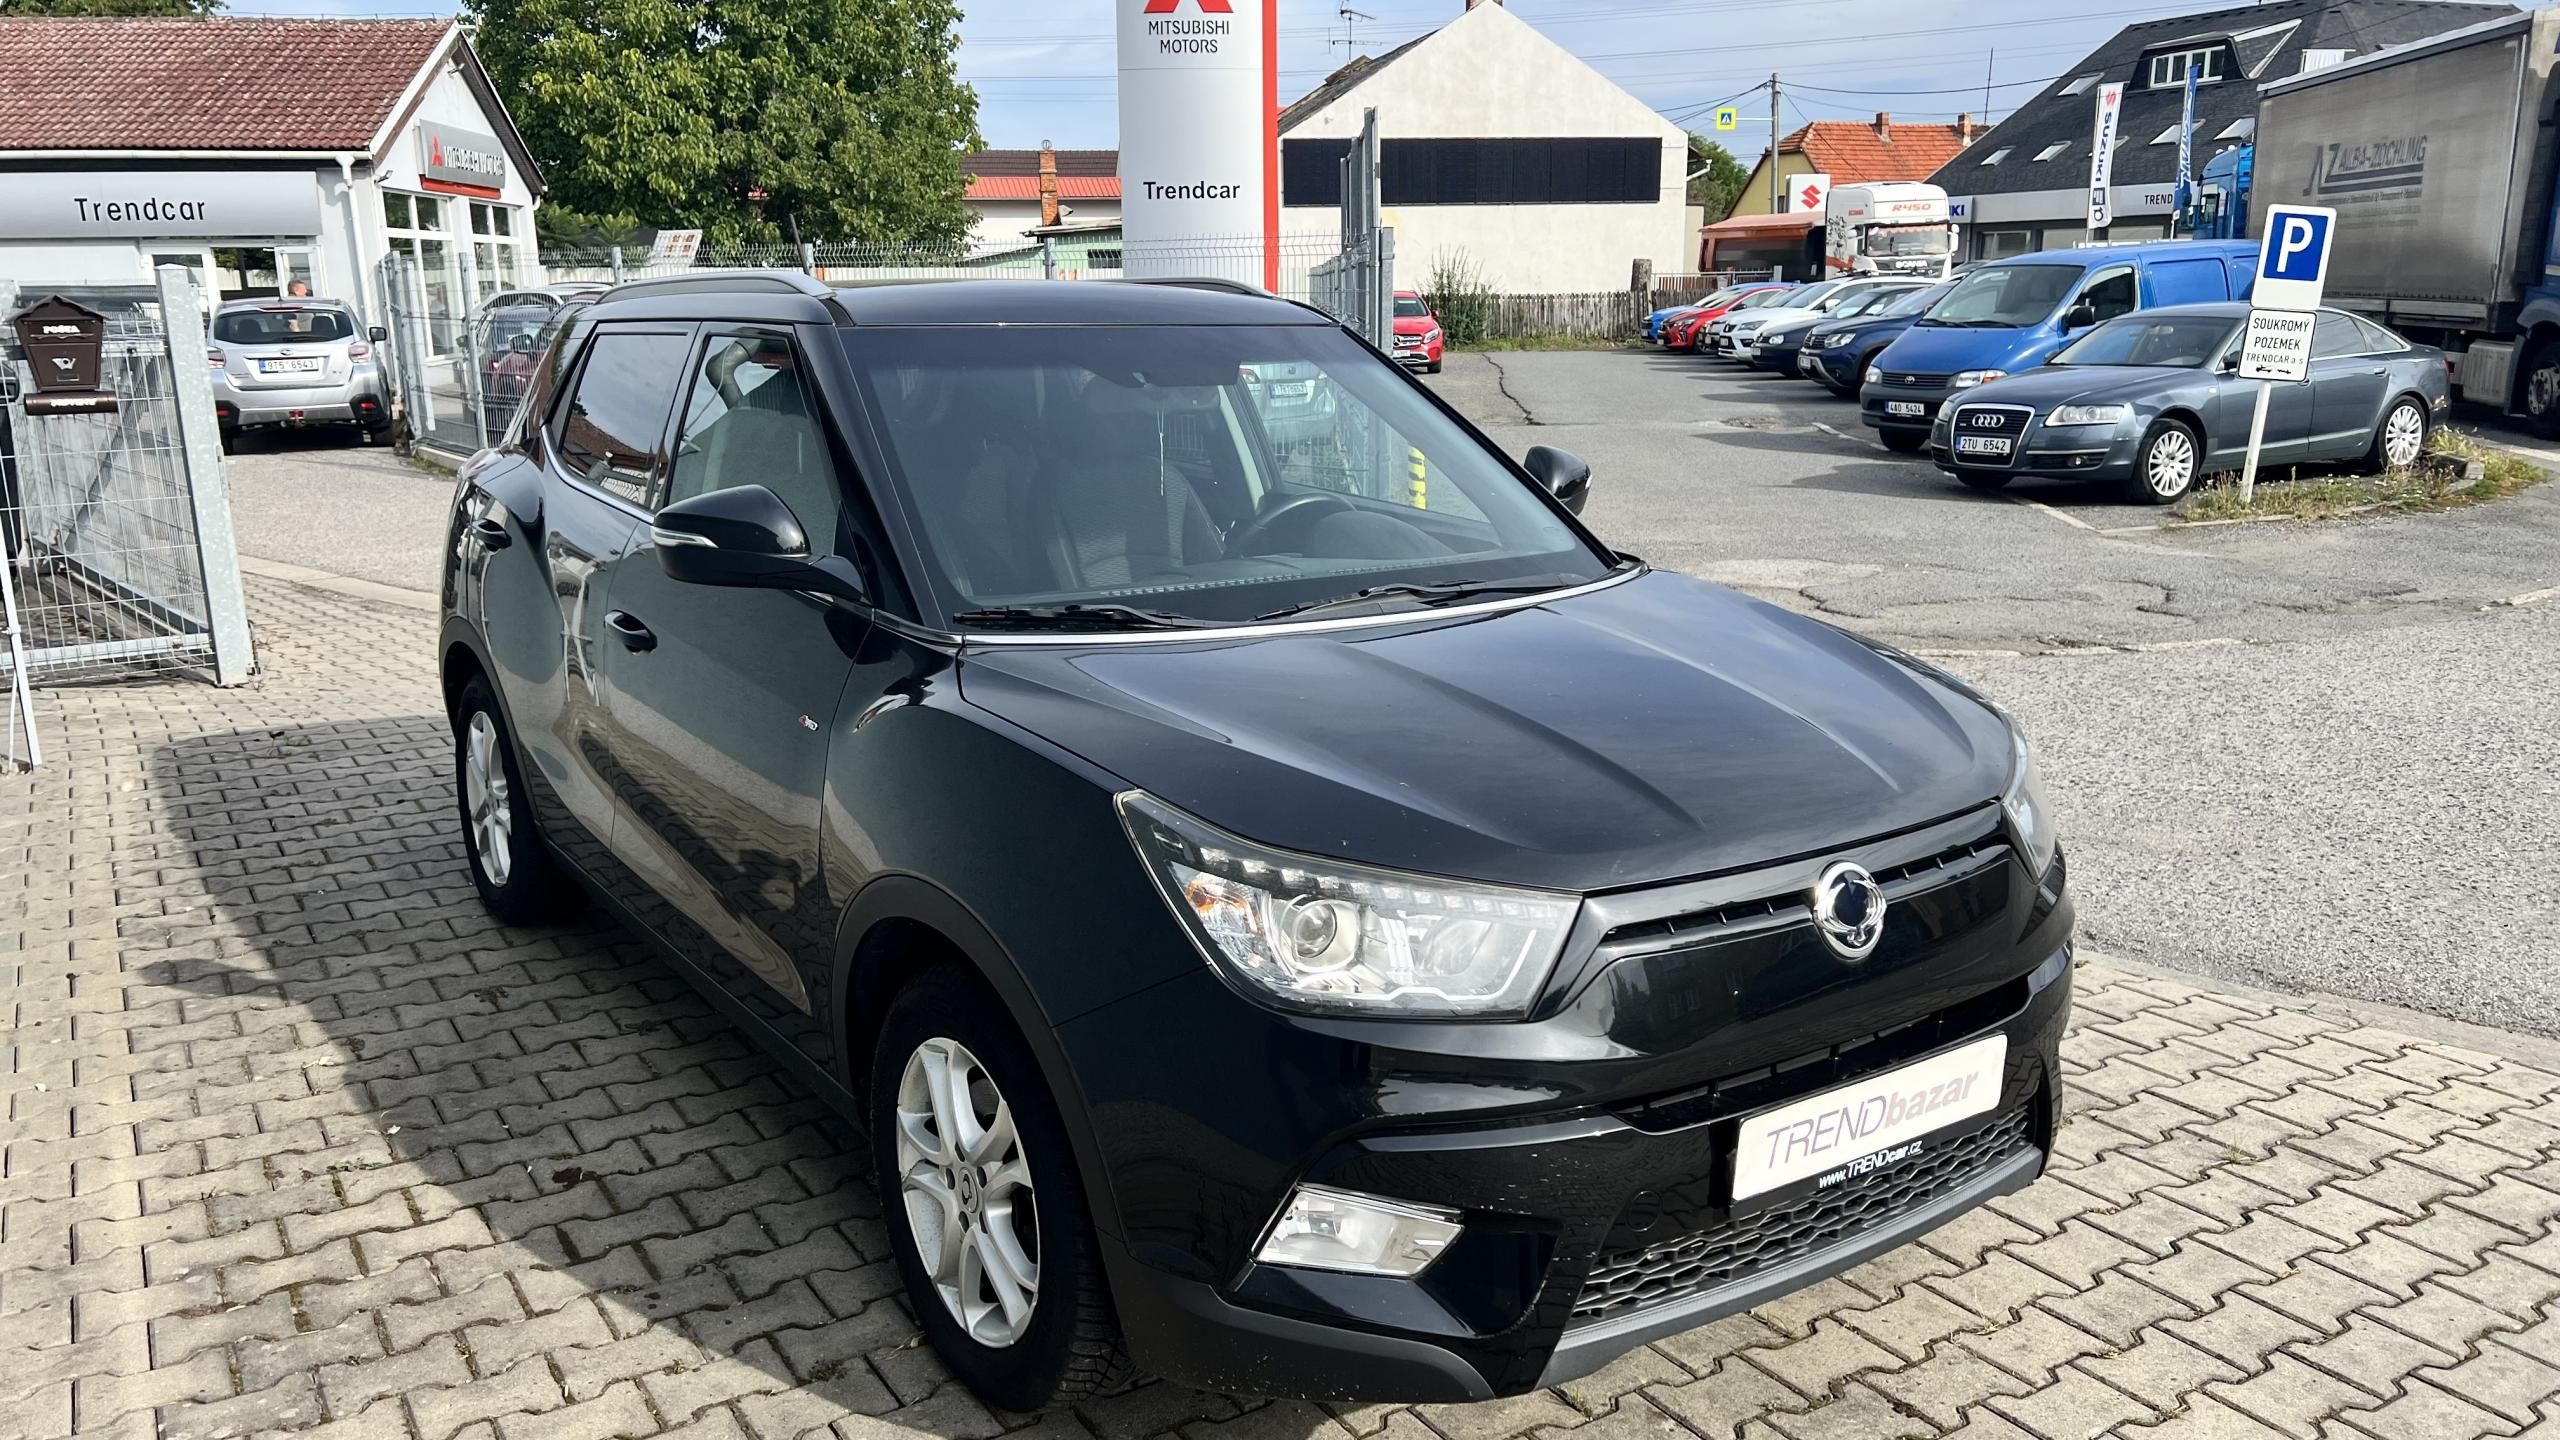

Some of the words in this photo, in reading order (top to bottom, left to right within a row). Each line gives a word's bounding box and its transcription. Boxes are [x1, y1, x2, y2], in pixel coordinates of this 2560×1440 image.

[1148, 20, 1230, 35] MITSUBISHI
[1160, 39, 1218, 54] MOTORS
[2095, 111, 2112, 182] SUZUKI
[1142, 180, 1241, 200] Trendcar
[73, 197, 206, 222] Trendcar
[1892, 203, 1931, 213] R450
[2276, 217, 2314, 273] P
[2254, 336, 2301, 350] POZEMEK
[2246, 352, 2290, 364] TRENDCAR
[1905, 403, 1922, 413] 5424
[1962, 438, 1978, 450] 2TU
[1983, 439, 2006, 451] 6542
[1767, 1071, 1979, 1169] TRENDbazar
[1819, 1140, 1923, 1189] www.TRENDcar.cz
